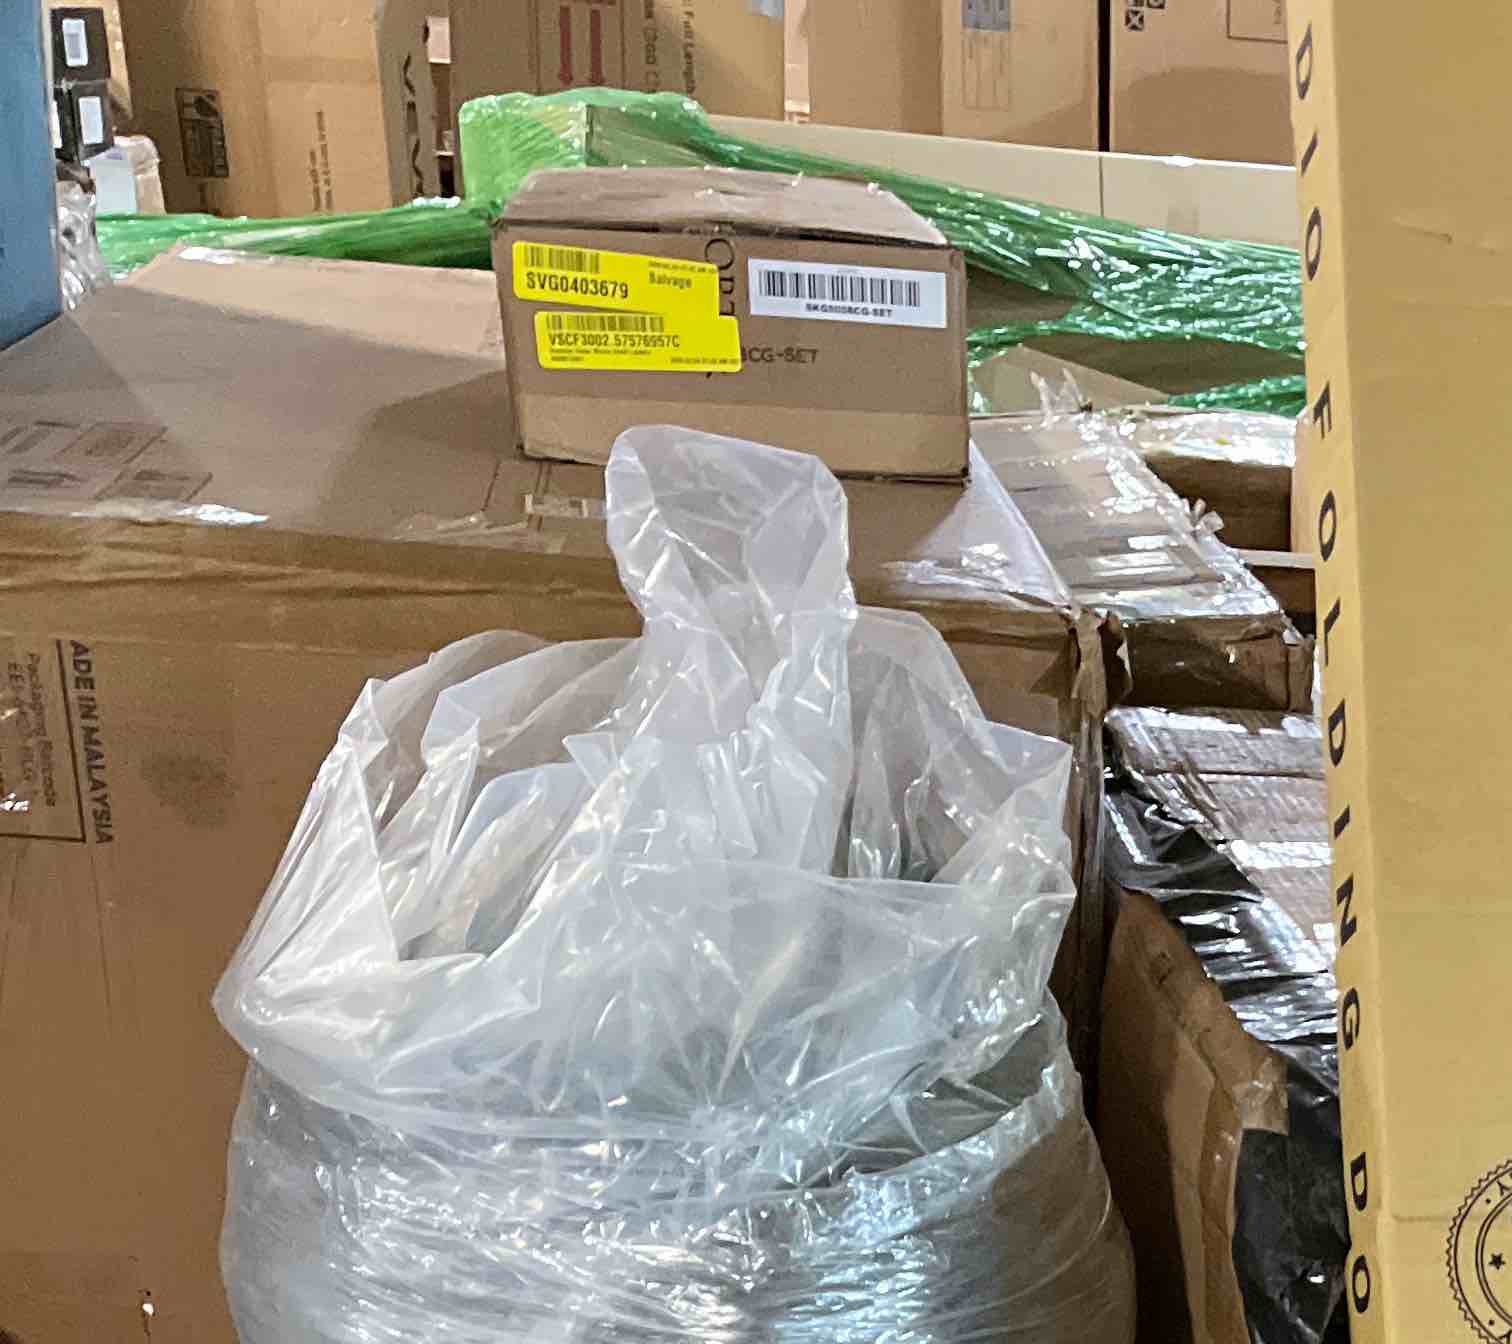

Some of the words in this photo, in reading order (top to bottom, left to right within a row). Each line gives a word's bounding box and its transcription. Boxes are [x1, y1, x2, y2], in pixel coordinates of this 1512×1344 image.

[526, 271, 629, 299] SVG0403679
[648, 271, 692, 289] Salvage
[70, 640, 95, 690] ADE
[80, 697, 98, 722] IN
[1307, 380, 1362, 1048] FOLDING
[84, 724, 113, 845] MALAYSIA
